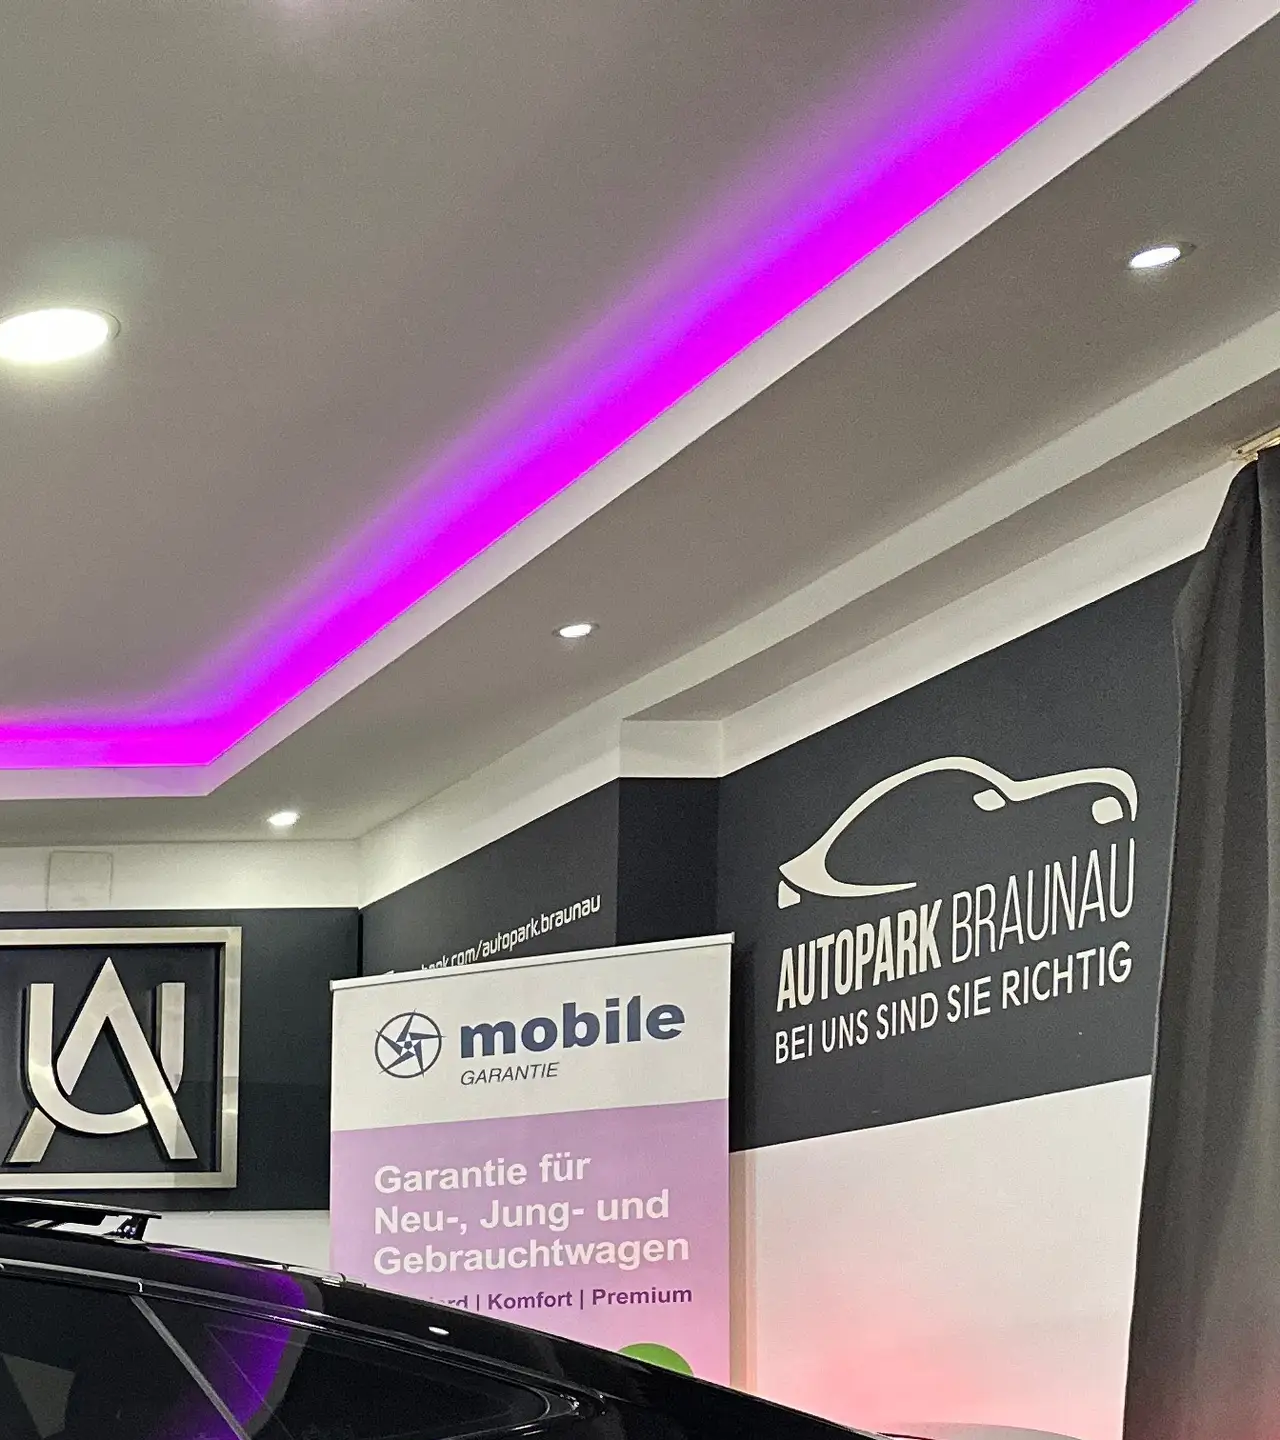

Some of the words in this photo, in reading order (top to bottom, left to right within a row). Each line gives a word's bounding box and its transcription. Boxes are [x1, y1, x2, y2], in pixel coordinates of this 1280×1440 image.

[776, 898, 943, 1013] AUTOPARK
[951, 837, 1135, 964] BRAUNAU
[775, 1023, 813, 1064] BEI
[821, 1009, 869, 1053] UNS
[875, 992, 939, 1040] SIND
[946, 975, 992, 1023] SIE
[1002, 940, 1132, 1010] RICHTIG
[460, 995, 686, 1059] mobile
[460, 1061, 560, 1086] GARANTIE
[374, 1157, 527, 1194] Garantie
[538, 1151, 591, 1183] für
[375, 1205, 467, 1235] Neu-,
[479, 1199, 585, 1232] Jung-
[597, 1189, 669, 1221] und
[373, 1238, 690, 1275] Gebrauchtwagen
[487, 1291, 574, 1310] Komfort
[592, 1286, 693, 1306] Premium
